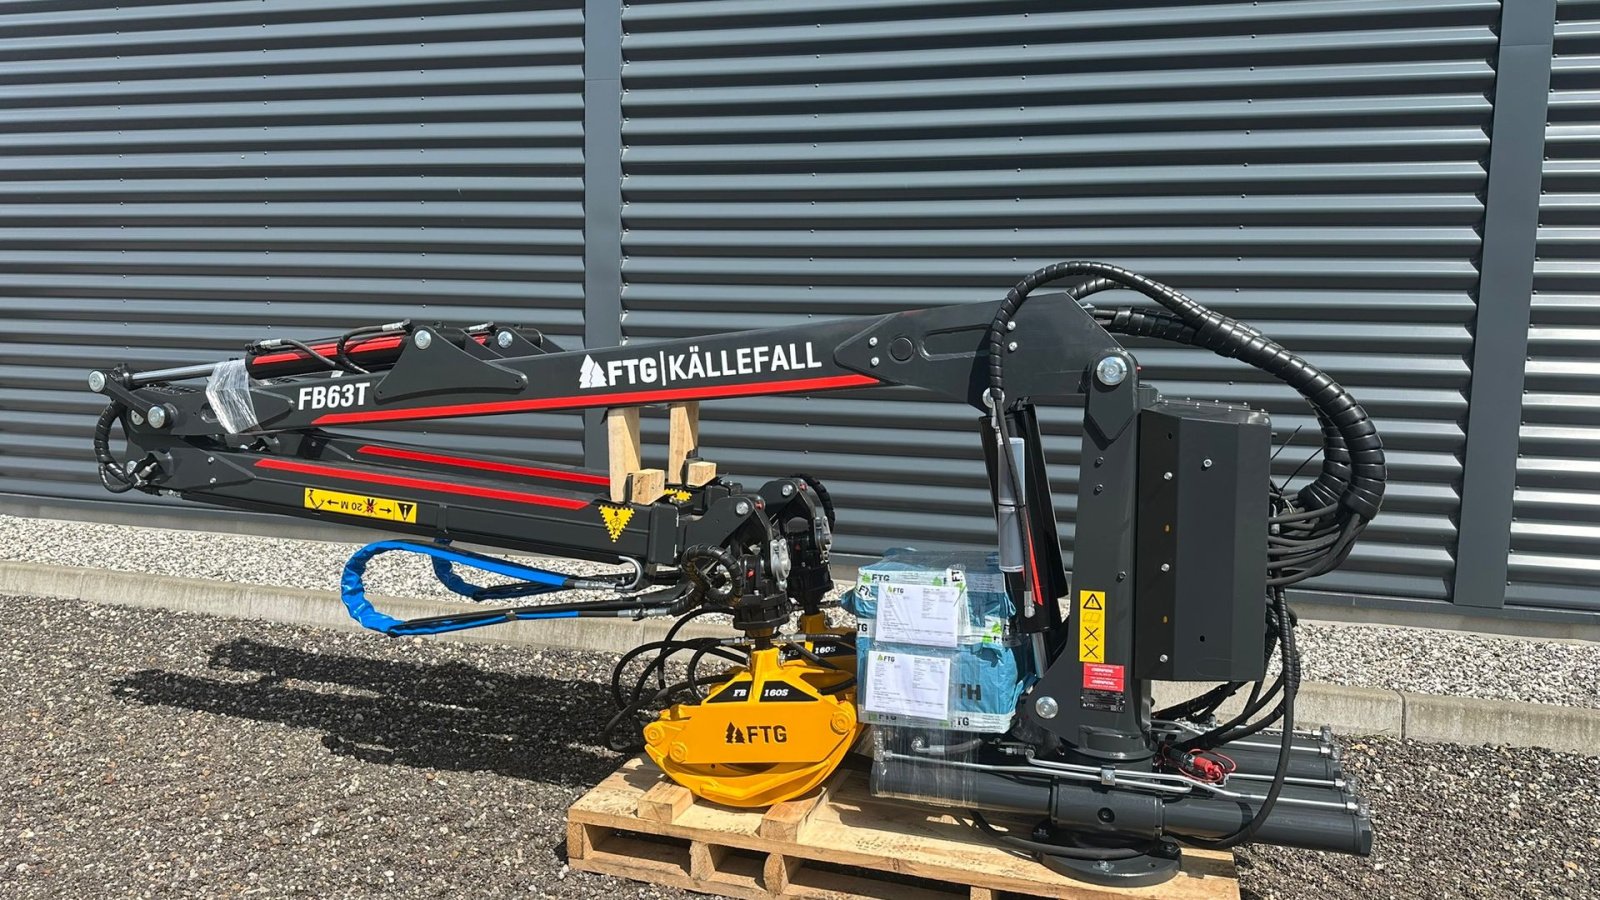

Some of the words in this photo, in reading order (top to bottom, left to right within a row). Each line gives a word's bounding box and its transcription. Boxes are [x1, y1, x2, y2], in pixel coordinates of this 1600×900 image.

[607, 357, 658, 386] FTG
[668, 342, 822, 381] KÄLLEFALL
[298, 382, 371, 410] FB63T
[340, 501, 349, 510] M
[352, 503, 363, 511] 20
[872, 574, 890, 582] FTG
[857, 623, 868, 632] TG
[815, 646, 836, 654] 160S
[884, 655, 895, 663] FTG
[733, 689, 747, 697] FB
[764, 689, 789, 697] 160S
[959, 684, 982, 701] TH
[746, 725, 788, 744] FTG
